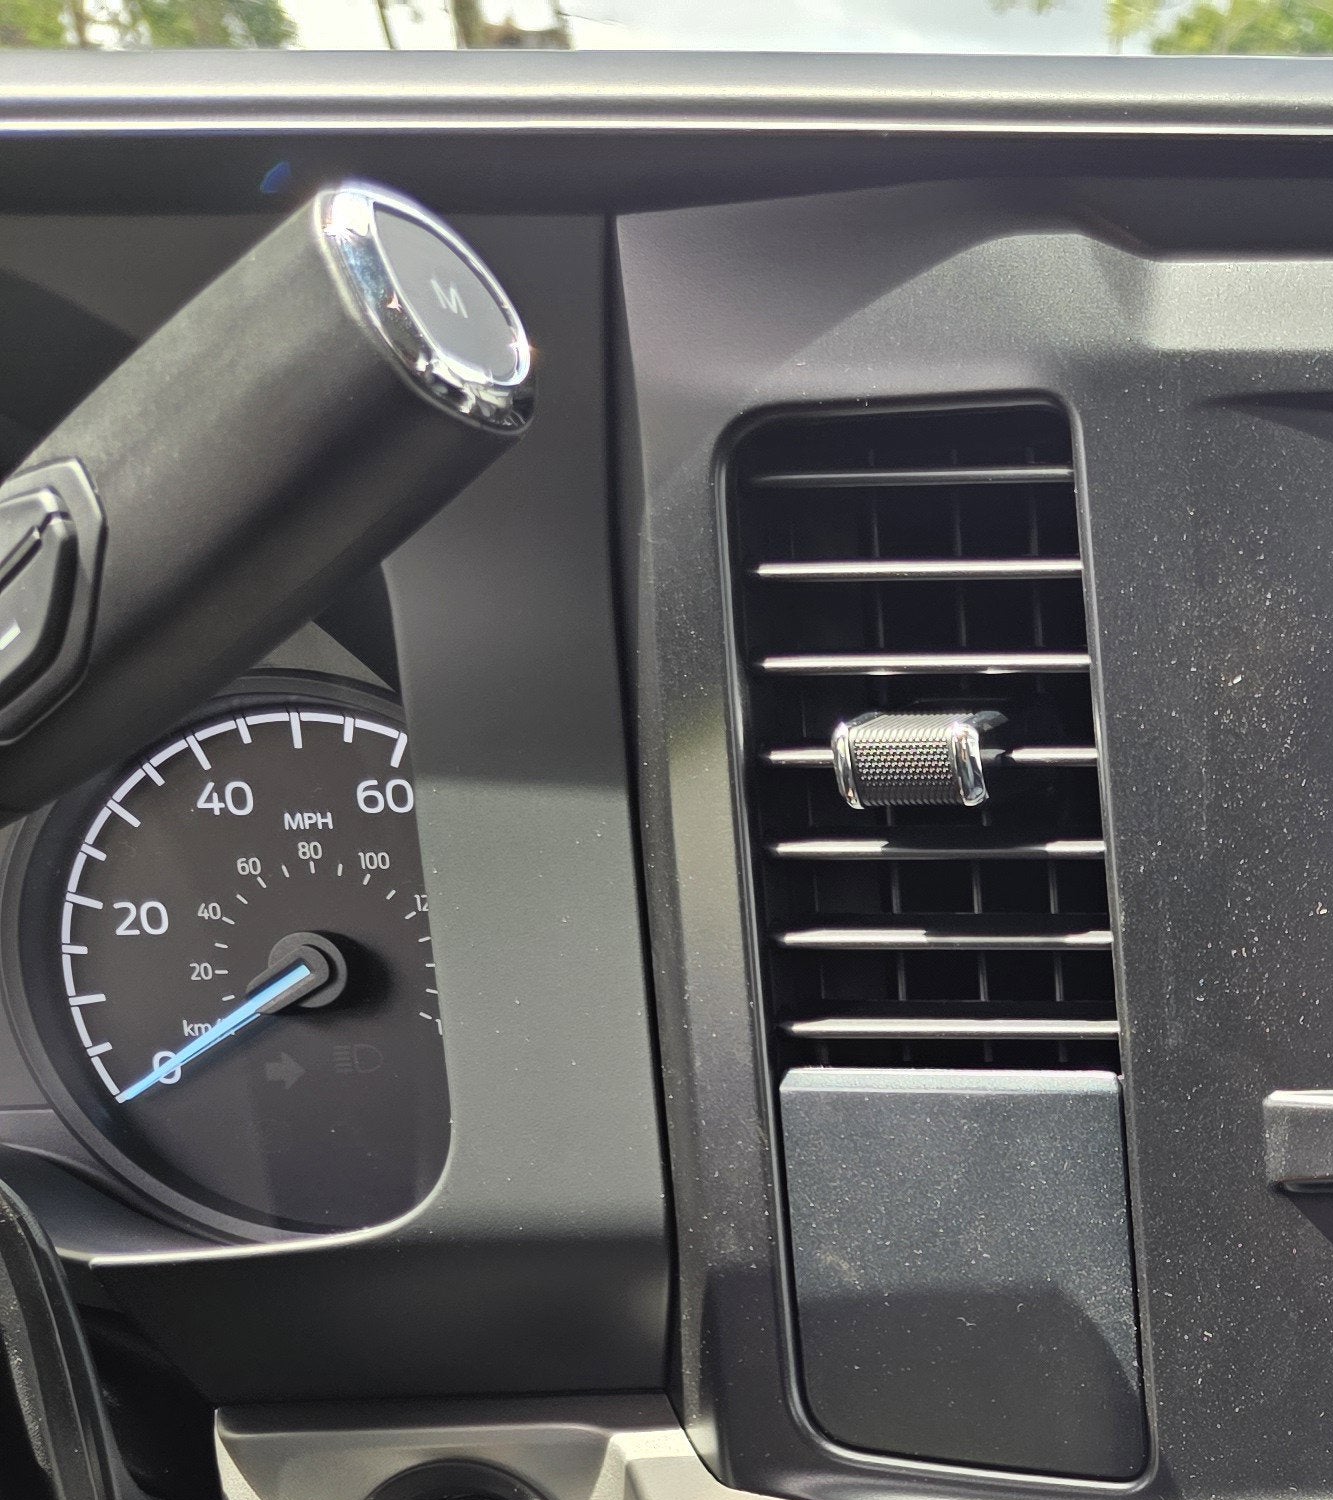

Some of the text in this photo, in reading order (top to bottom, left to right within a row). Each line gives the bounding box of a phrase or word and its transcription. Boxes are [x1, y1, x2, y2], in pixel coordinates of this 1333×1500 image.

[196, 781, 254, 816] 40
[356, 779, 414, 814] 60
[283, 812, 333, 830] MPH
[297, 841, 323, 860] 80
[236, 857, 261, 875] 60
[358, 852, 390, 870] 100
[113, 900, 169, 936] 20
[197, 903, 222, 920] 40
[190, 962, 213, 981] 20
